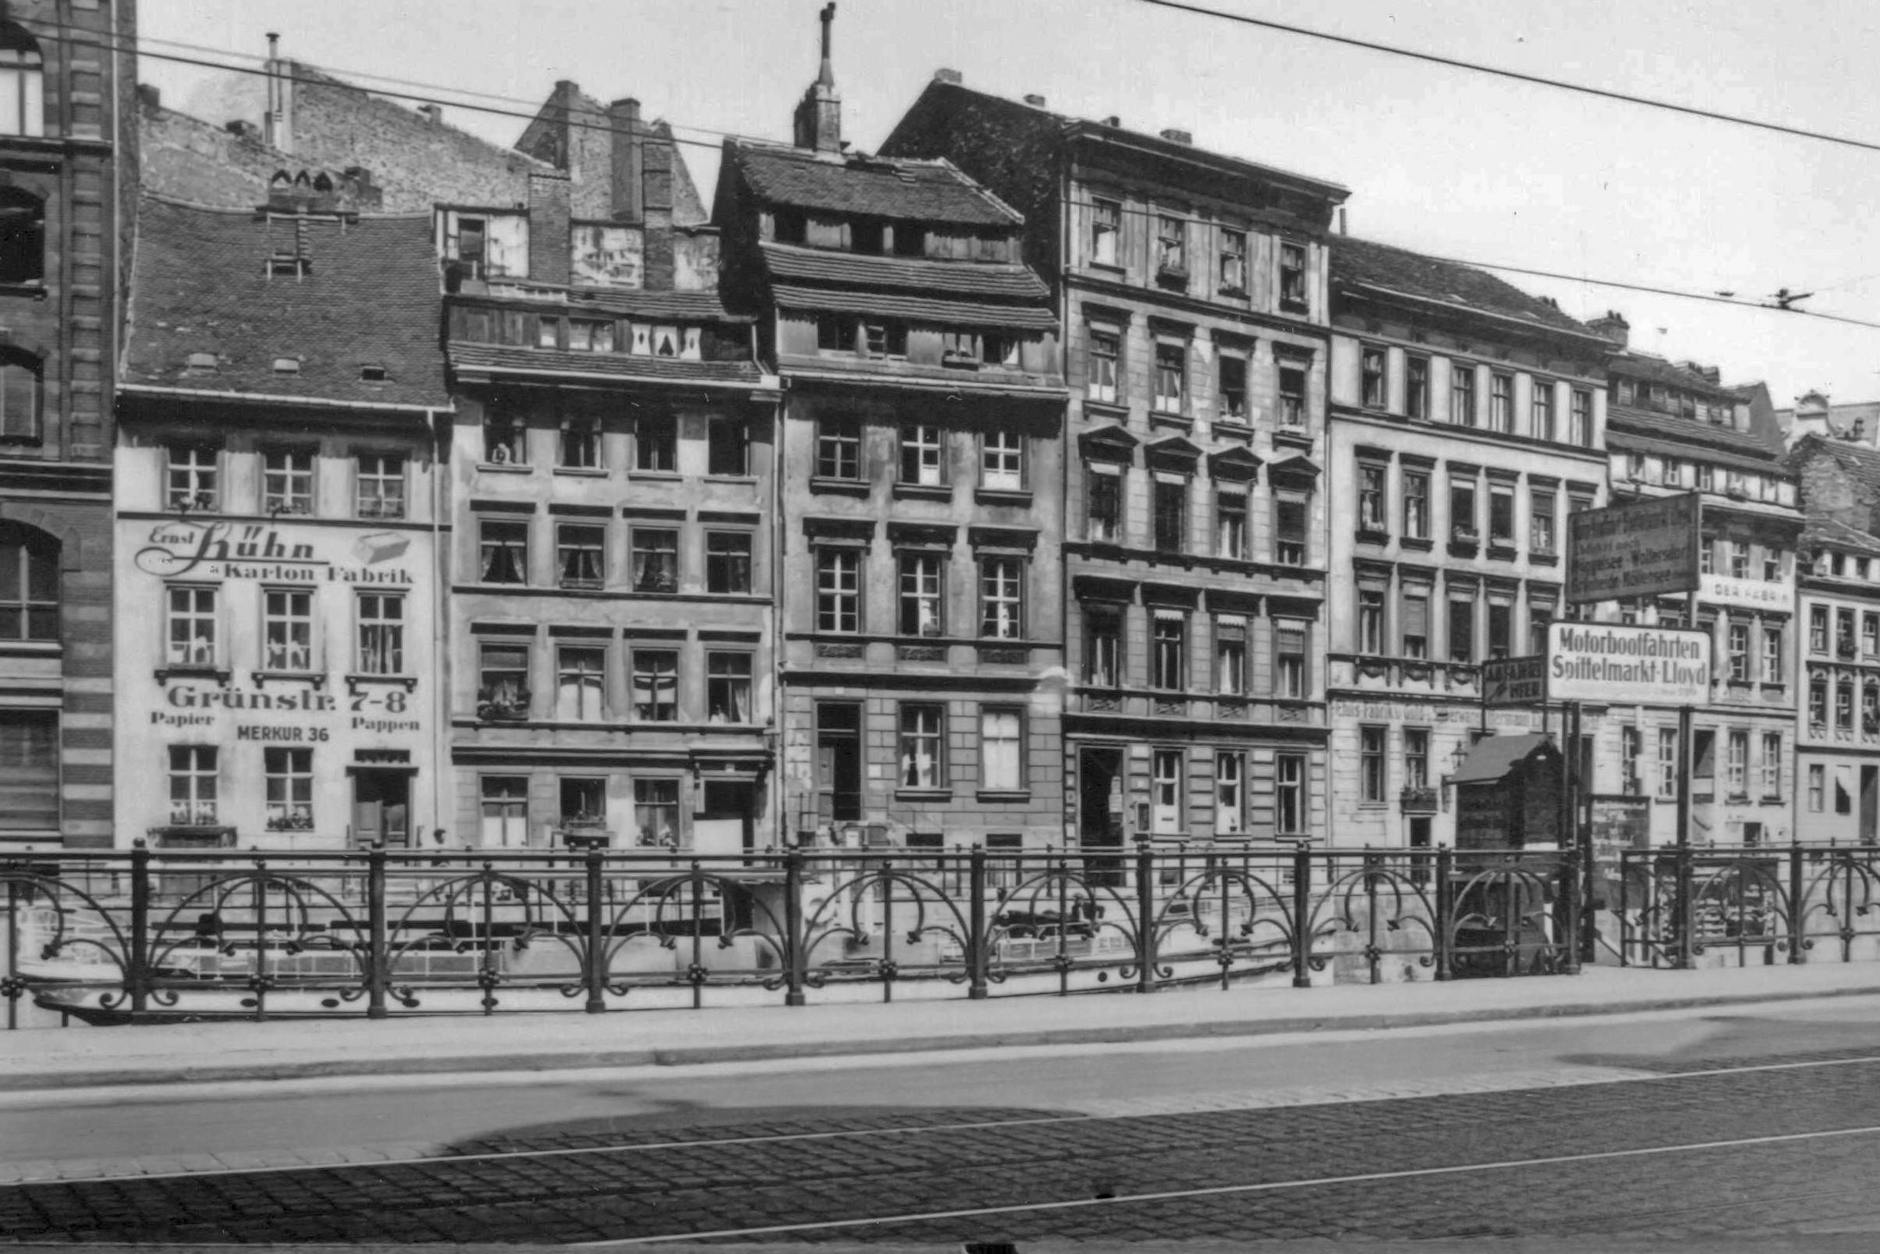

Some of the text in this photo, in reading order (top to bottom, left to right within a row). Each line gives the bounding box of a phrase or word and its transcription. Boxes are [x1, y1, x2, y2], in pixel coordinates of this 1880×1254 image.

[148, 521, 315, 572] Ernst Kühn
[224, 562, 414, 584] Karton Fabrik
[1559, 627, 1701, 660] Motorbootfahrten
[1552, 654, 1707, 686] Spittelmarkt-Lloyd
[167, 685, 407, 714] Grünstr. 7-8
[150, 711, 216, 727] Papier
[351, 716, 421, 733] Pappen
[237, 726, 330, 742] MERKUR 36
